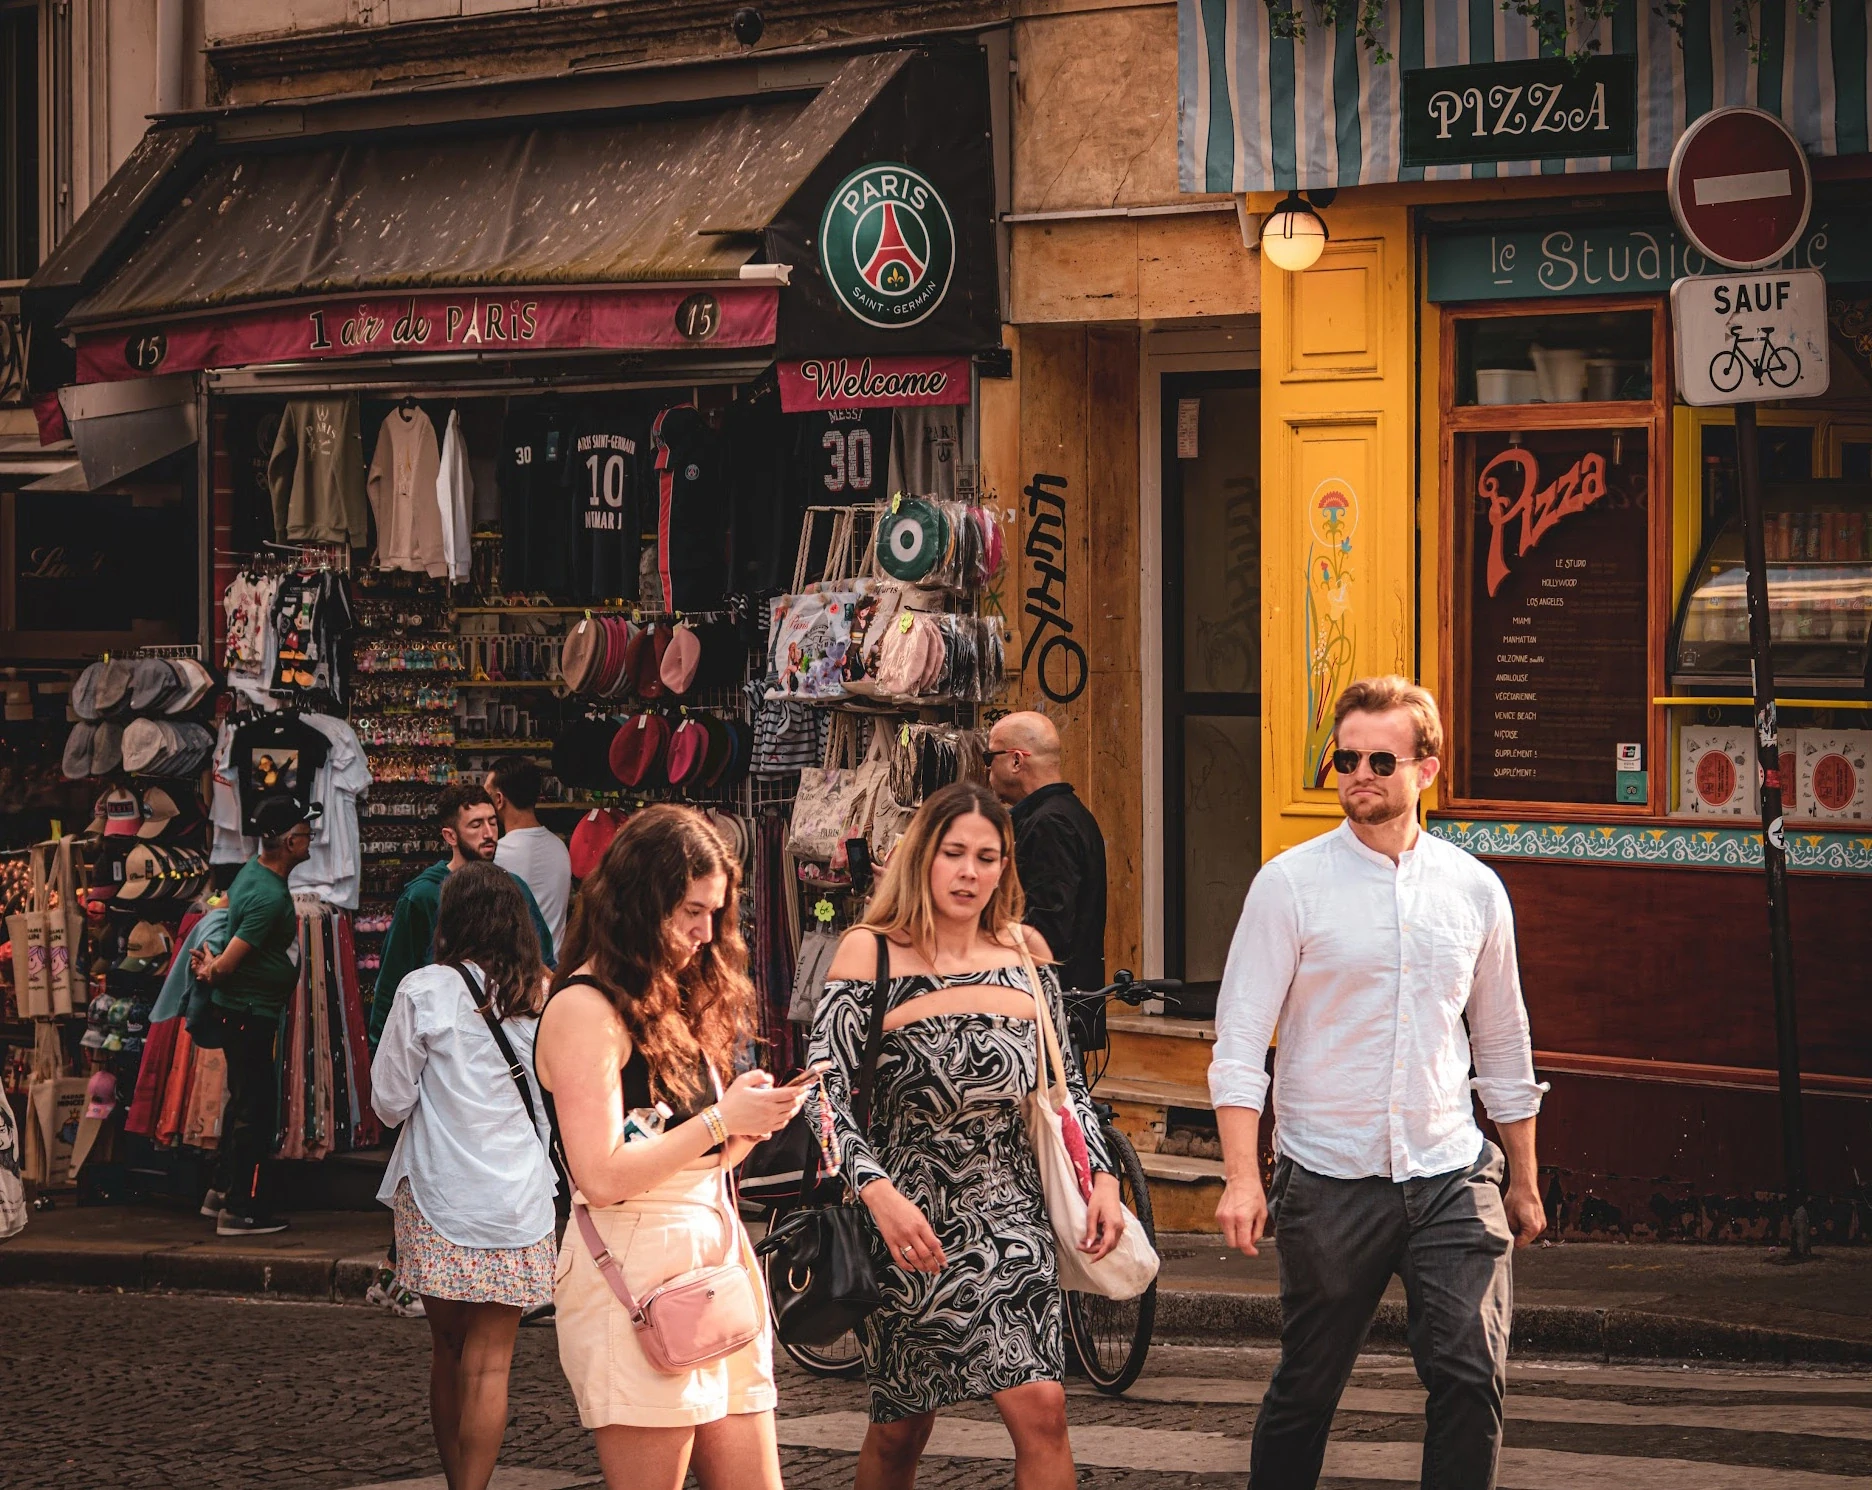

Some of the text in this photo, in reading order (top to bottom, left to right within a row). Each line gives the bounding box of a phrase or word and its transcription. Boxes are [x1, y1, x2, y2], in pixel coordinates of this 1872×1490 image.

[1428, 81, 1610, 140] PIZZA
[842, 174, 929, 216] PARIS
[1491, 236, 1516, 276] le
[1538, 231, 1705, 291] Studio
[852, 280, 937, 315] SAINT GERMAIN
[1714, 282, 1791, 315] SAUF
[309, 309, 332, 350] 1
[340, 303, 386, 346] air
[391, 297, 432, 343] de
[687, 303, 713, 336] 15
[135, 335, 160, 367] 15
[801, 357, 948, 401] Welcome
[305, 422, 336, 440] PARIS
[828, 408, 863, 423] MESSI
[515, 446, 532, 465] 30
[577, 435, 592, 452] ARIS
[823, 429, 872, 491] 30
[586, 454, 624, 507] 10
[1478, 448, 1607, 598] Pizza
[1556, 559, 1563, 568] LE
[1564, 559, 1587, 569] STUDIO
[1541, 579, 1578, 587] HOLLYWOOD
[1526, 598, 1538, 607] LOS
[1539, 597, 1564, 607] ANGELES
[1512, 617, 1532, 625] MIAMI
[1503, 635, 1537, 644] MANHATTAN
[1497, 654, 1528, 663] CALZONNE
[1494, 711, 1537, 720] VENICE BEACH
